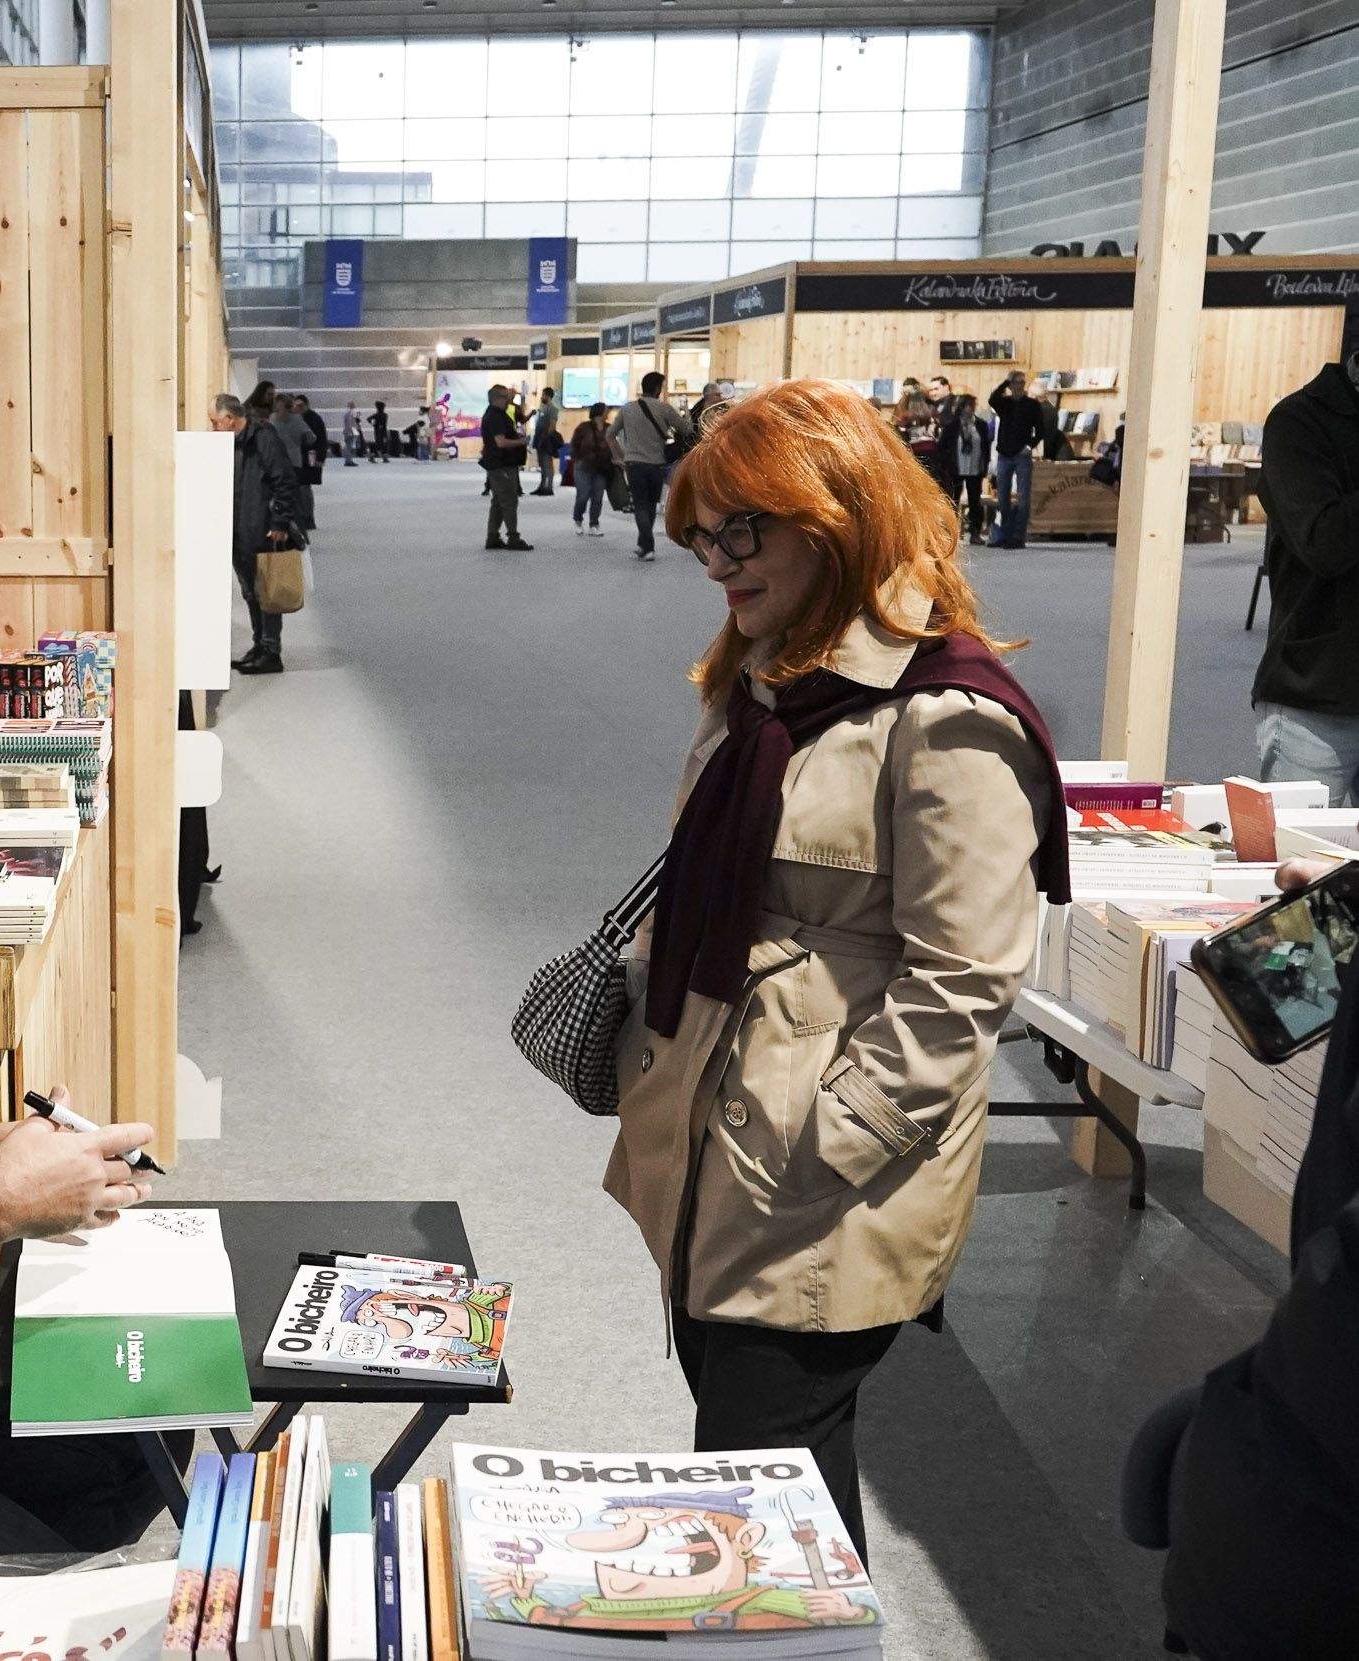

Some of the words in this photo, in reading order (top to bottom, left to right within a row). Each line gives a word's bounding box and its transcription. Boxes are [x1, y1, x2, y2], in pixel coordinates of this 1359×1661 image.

[44, 661, 64, 687] POR
[284, 1270, 339, 1336] bicheiro
[127, 1331, 144, 1340] O
[278, 1337, 312, 1352] O
[127, 1341, 145, 1382] bicheiro
[362, 1365, 392, 1375] bicheiro
[472, 1454, 524, 1478] O
[540, 1459, 803, 1483] bicheiro
